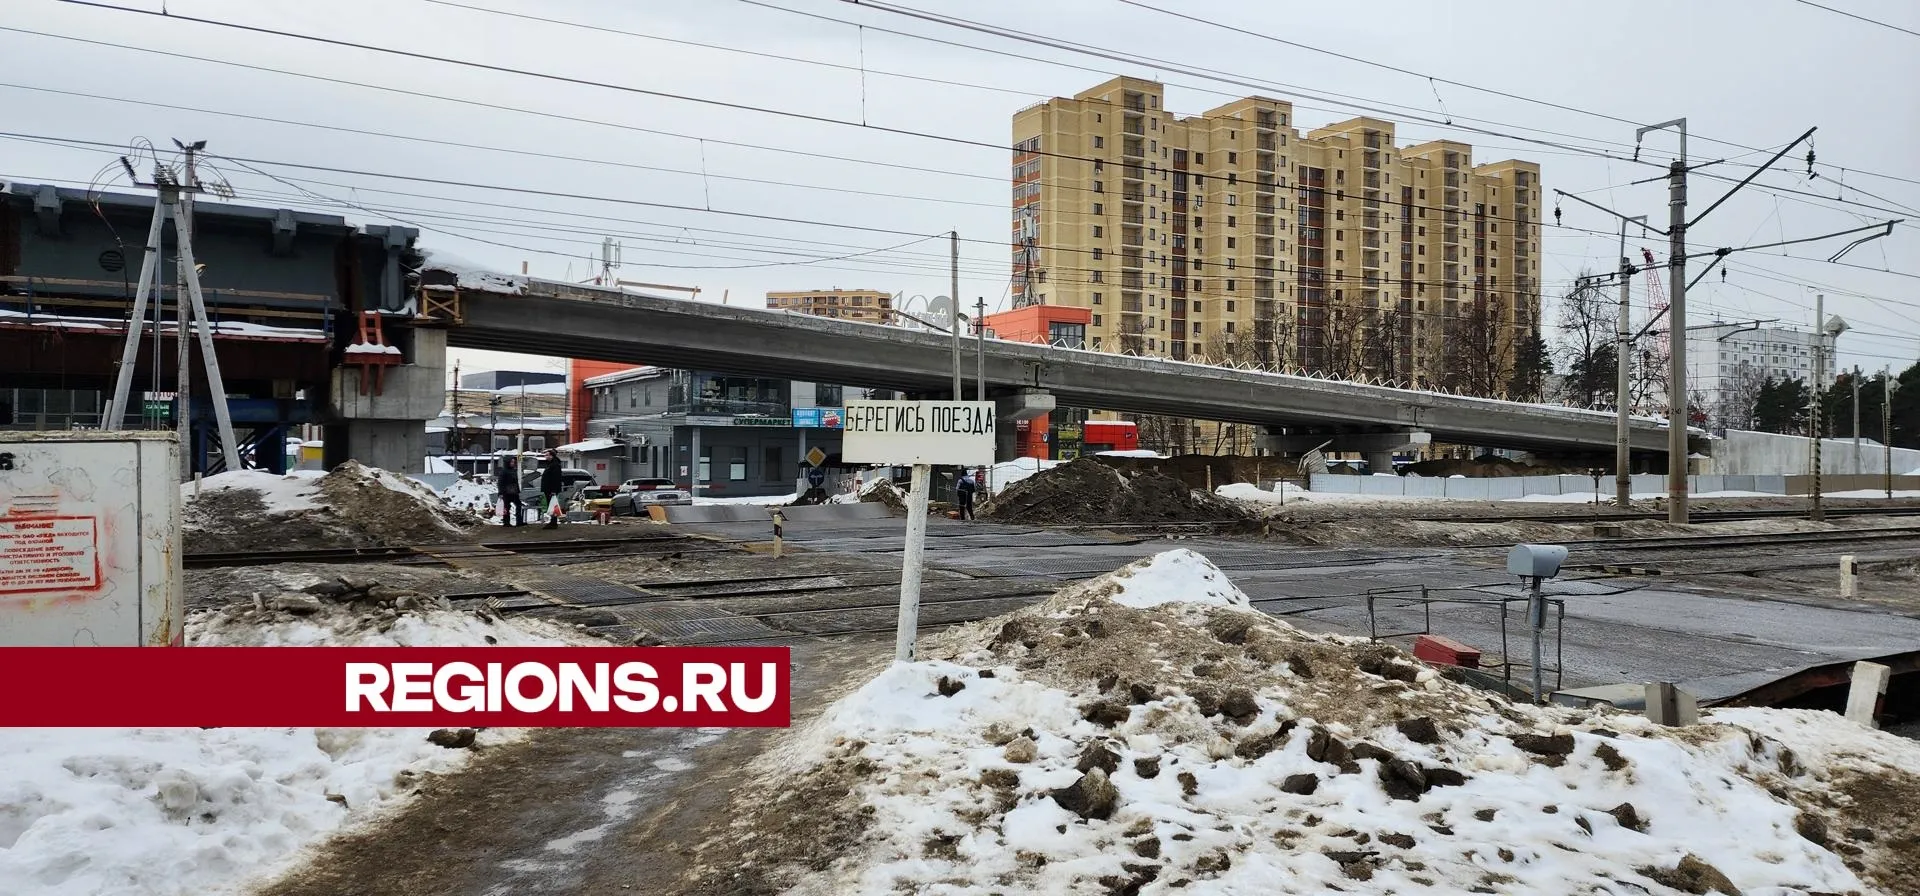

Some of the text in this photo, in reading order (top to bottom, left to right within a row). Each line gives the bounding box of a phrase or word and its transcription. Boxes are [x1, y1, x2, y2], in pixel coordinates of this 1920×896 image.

[733, 417, 792, 426] СУПЕРМАРКЕТ
[845, 405, 994, 435] БЕРЕГИСЬ ПОЕЗДА
